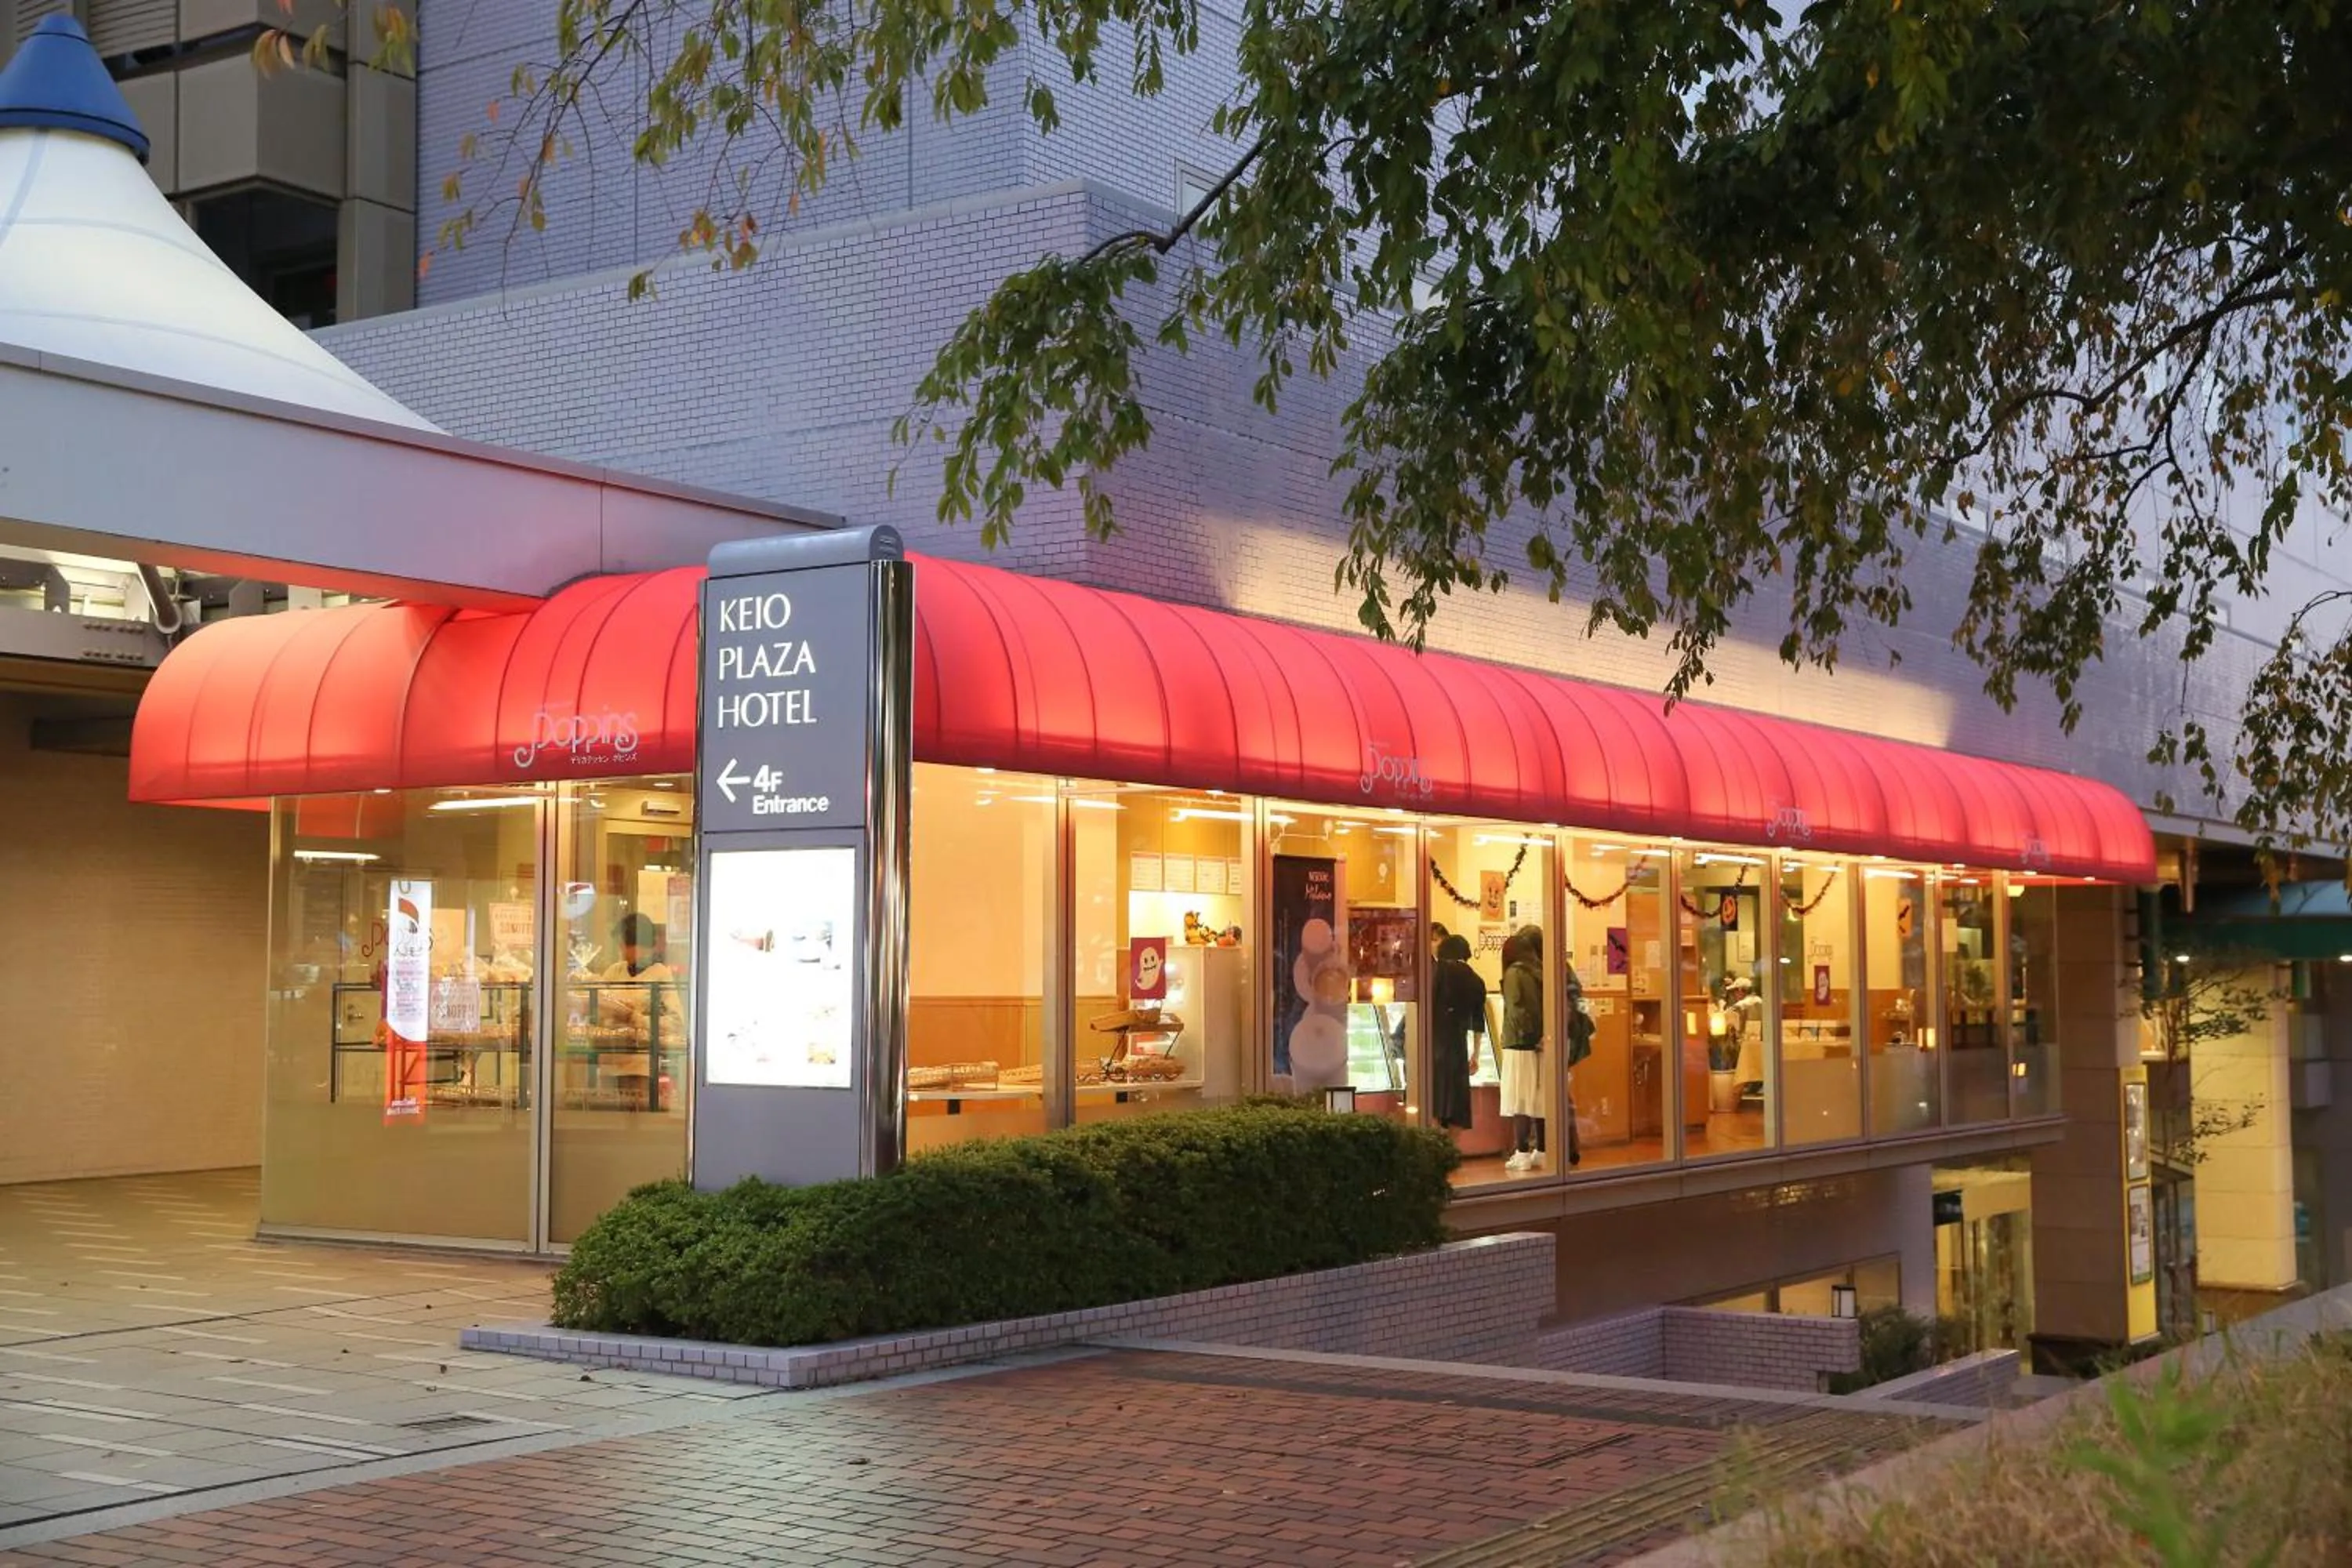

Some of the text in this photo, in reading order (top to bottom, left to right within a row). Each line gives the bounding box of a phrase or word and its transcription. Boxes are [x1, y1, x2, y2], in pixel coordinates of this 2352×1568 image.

[719, 593, 791, 633] KEIO
[718, 640, 816, 681] PLAZA
[717, 689, 817, 729] HOTEL
[514, 700, 639, 768] Poppins
[753, 764, 783, 793] 4F
[752, 794, 829, 815] Entrance
